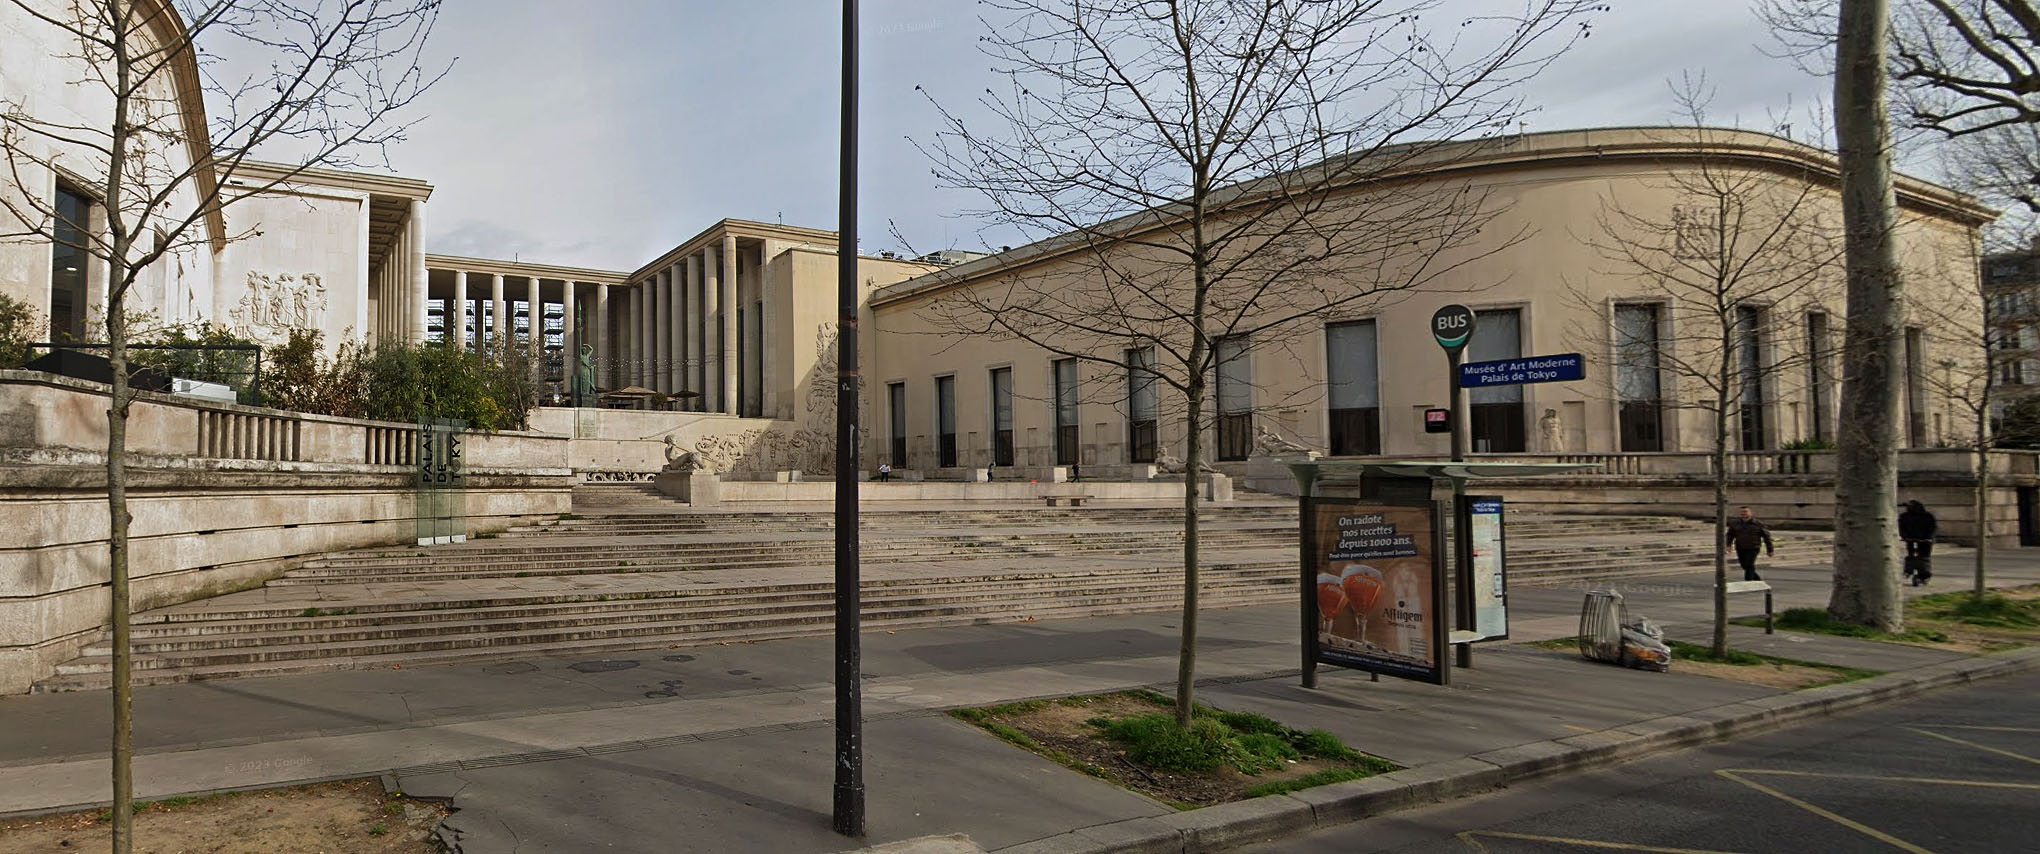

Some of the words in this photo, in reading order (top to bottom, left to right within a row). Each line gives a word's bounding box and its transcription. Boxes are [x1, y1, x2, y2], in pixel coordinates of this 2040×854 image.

[1438, 314, 1467, 330] BUS
[1465, 365, 1495, 375] Musée
[1510, 362, 1526, 371] Art
[1528, 358, 1576, 370] Moderne
[1481, 371, 1509, 383] Palais
[1511, 373, 1525, 381] de
[1528, 370, 1558, 381] Tokyo
[423, 423, 433, 483] PALAIS
[437, 463, 447, 483] DE
[1338, 516, 1352, 527] On
[1353, 514, 1382, 525] radote
[1342, 529, 1359, 537] nos
[1360, 526, 1393, 536] recettes
[1338, 539, 1368, 550] depuis
[1369, 538, 1392, 547] 1000
[1393, 537, 1412, 545] ans.
